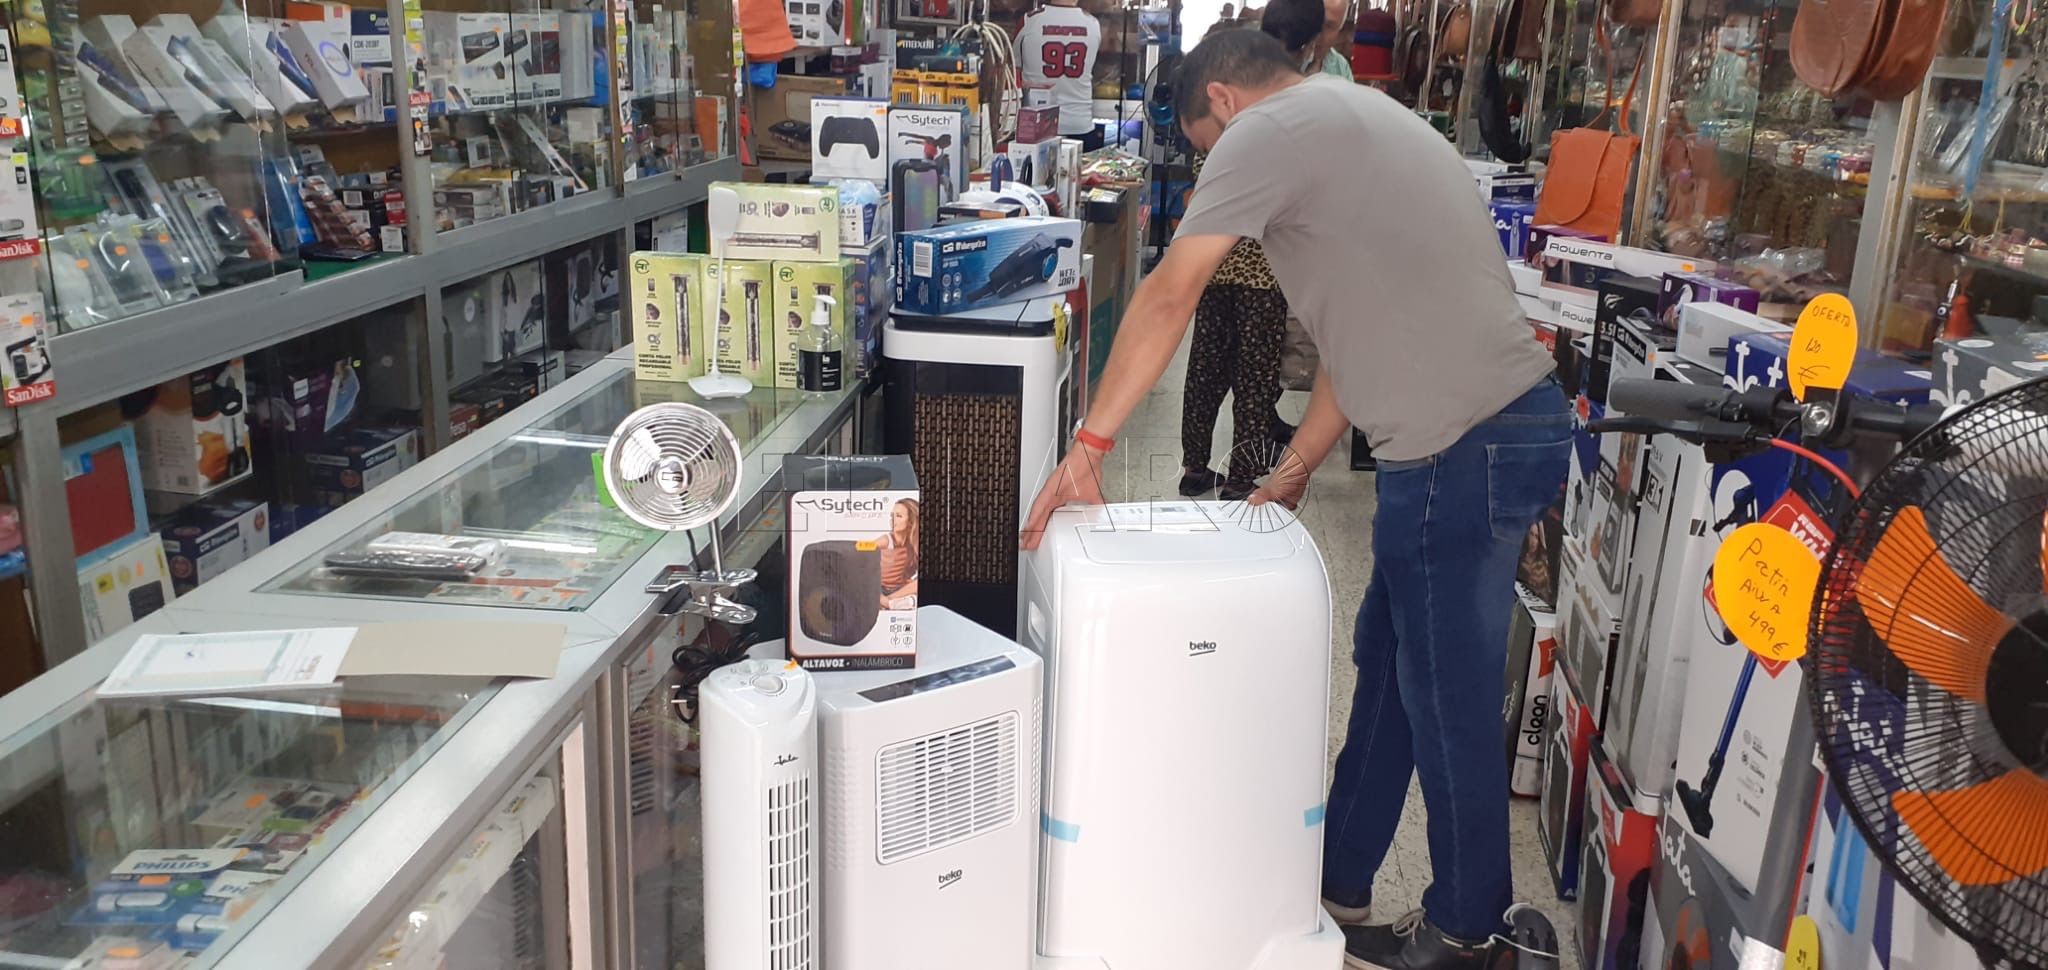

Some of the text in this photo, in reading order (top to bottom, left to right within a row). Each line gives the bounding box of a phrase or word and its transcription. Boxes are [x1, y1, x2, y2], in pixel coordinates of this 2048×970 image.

[1042, 41, 1088, 79] 93
[911, 114, 950, 127] Sytech
[7, 384, 53, 405] SanDisk
[821, 498, 884, 514] Sytech
[1189, 641, 1217, 651] beko
[802, 659, 845, 669] ALTAVOZ
[1522, 694, 1548, 746] clean
[133, 861, 211, 871] PHILIPS
[938, 868, 963, 884] beko
